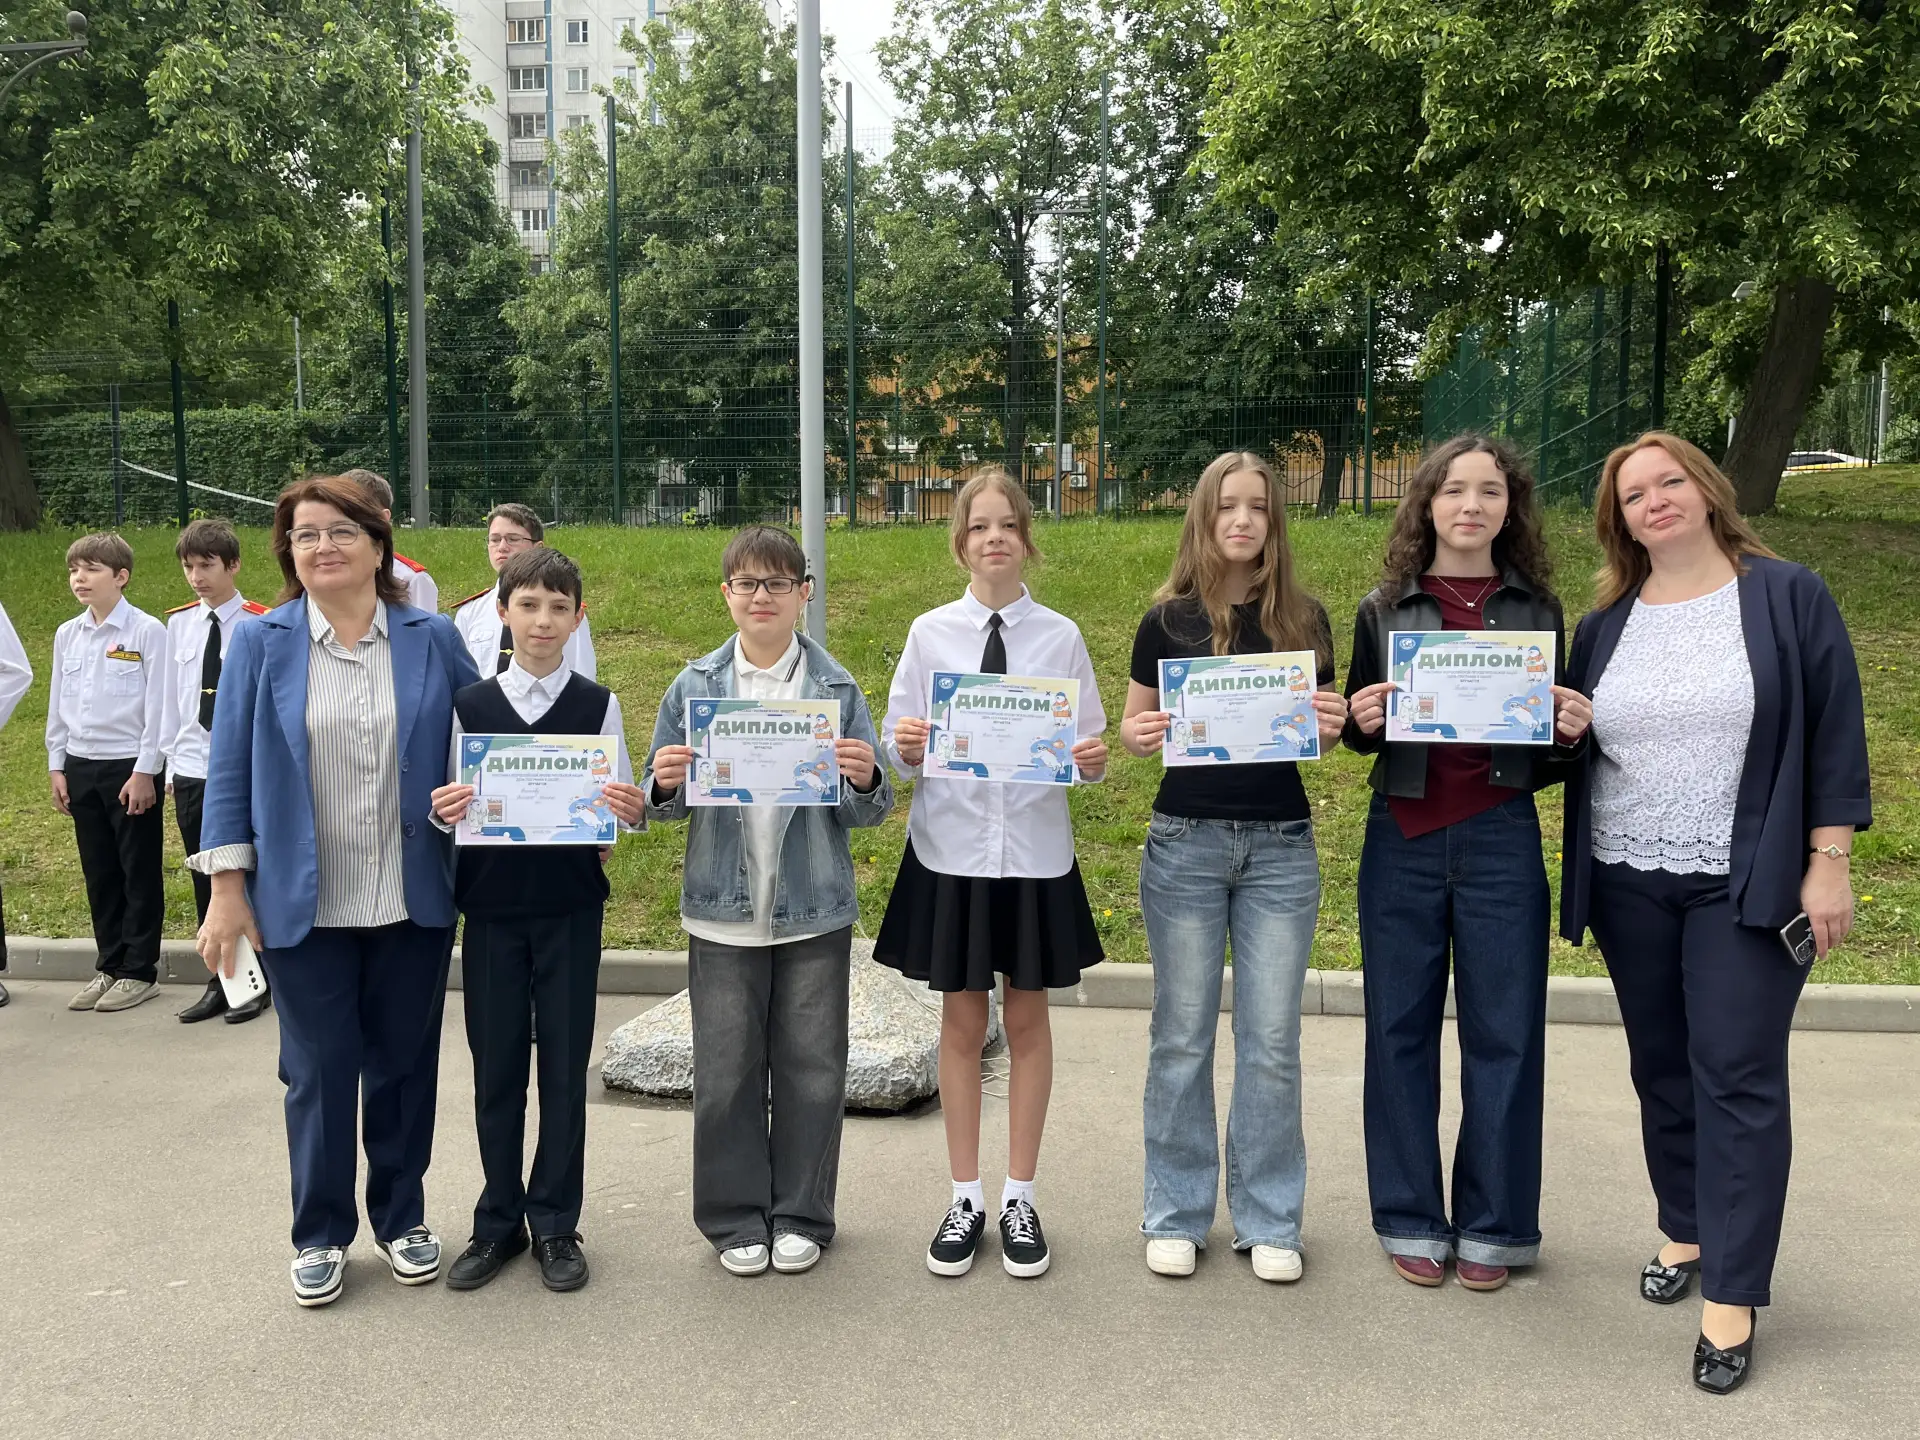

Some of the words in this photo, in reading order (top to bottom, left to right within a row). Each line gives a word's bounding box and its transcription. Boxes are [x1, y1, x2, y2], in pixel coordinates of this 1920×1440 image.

[1418, 653, 1522, 669] ДИПЛОМ
[1188, 675, 1286, 695] ДИПЛОМ
[955, 694, 1049, 711] ДИПЛОМ
[714, 721, 811, 736] ДИПЛОМ
[487, 757, 587, 772] ДИПЛОМ
